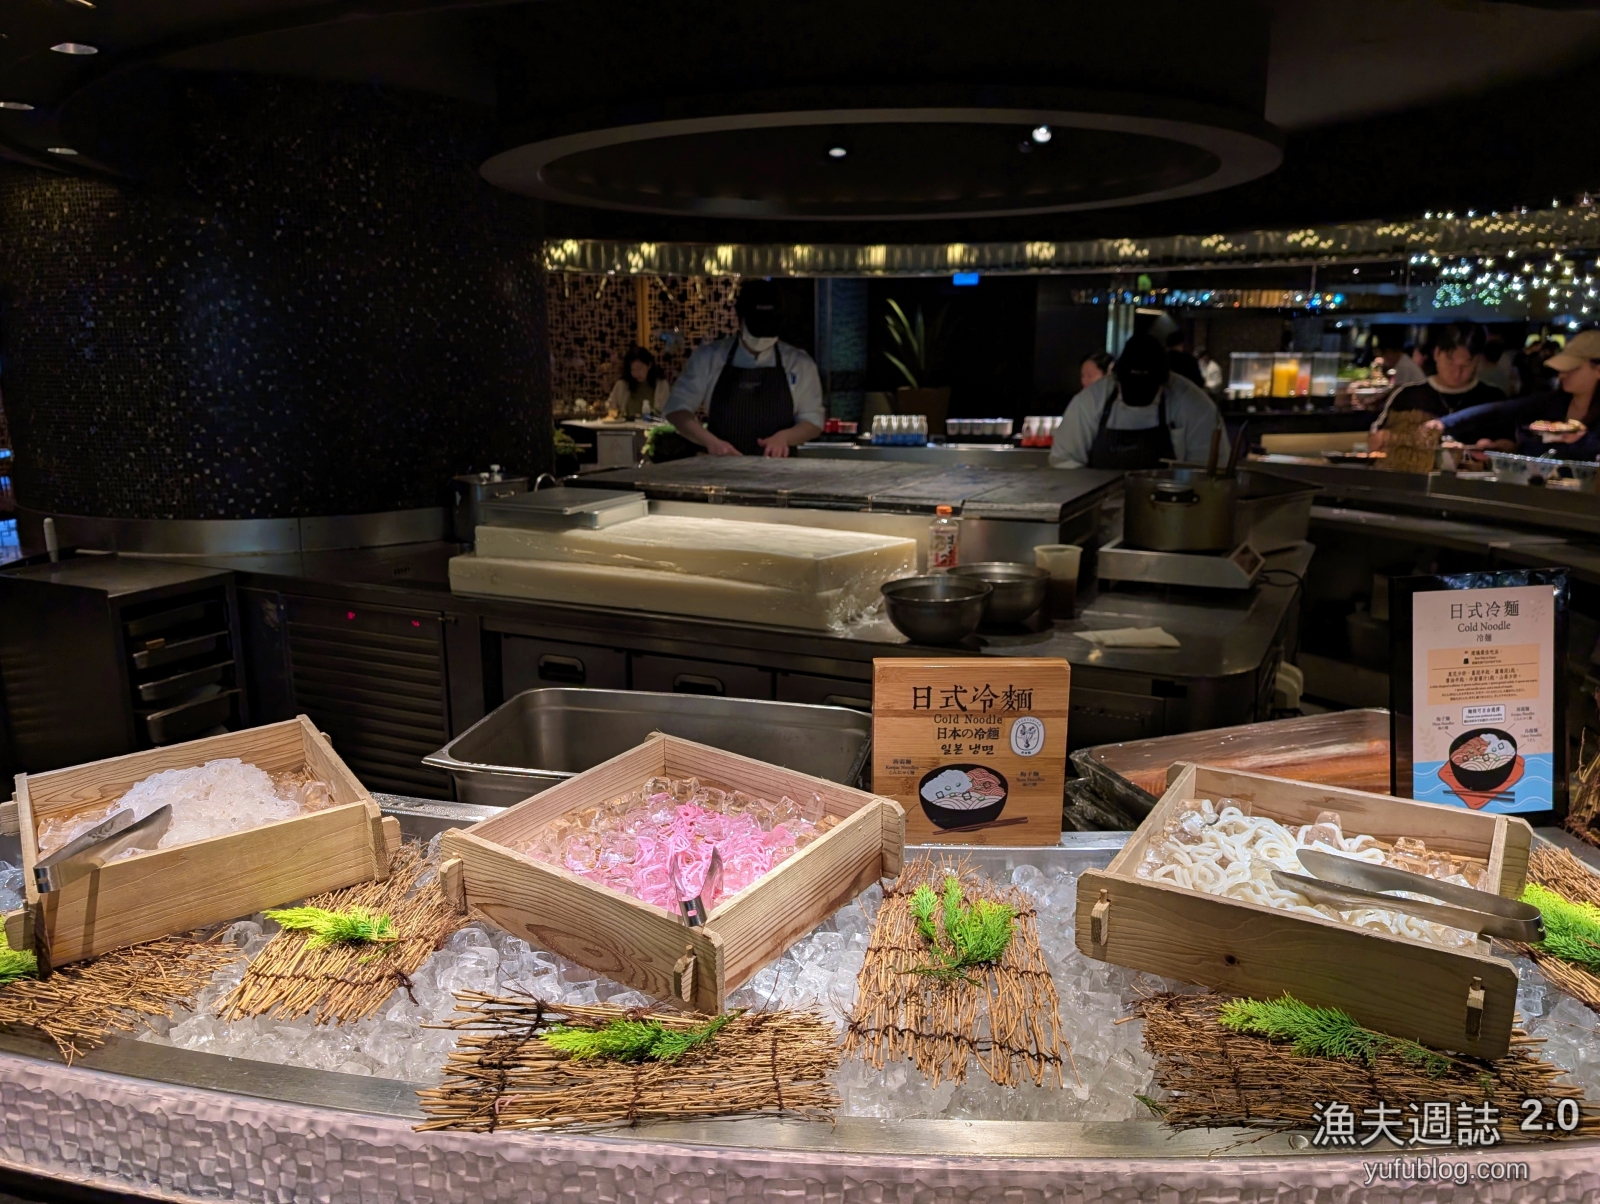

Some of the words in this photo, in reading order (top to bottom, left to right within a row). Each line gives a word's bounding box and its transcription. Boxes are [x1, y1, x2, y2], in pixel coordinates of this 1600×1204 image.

[1450, 599, 1520, 620] 日式冷麵
[1457, 622, 1478, 632] Cold
[1480, 620, 1511, 631] Noodle
[912, 684, 1033, 714] 日式冷麵
[934, 714, 960, 725] Cold
[964, 714, 1003, 725] Noodle
[941, 743, 964, 755] 일본
[968, 743, 995, 755] 냉면
